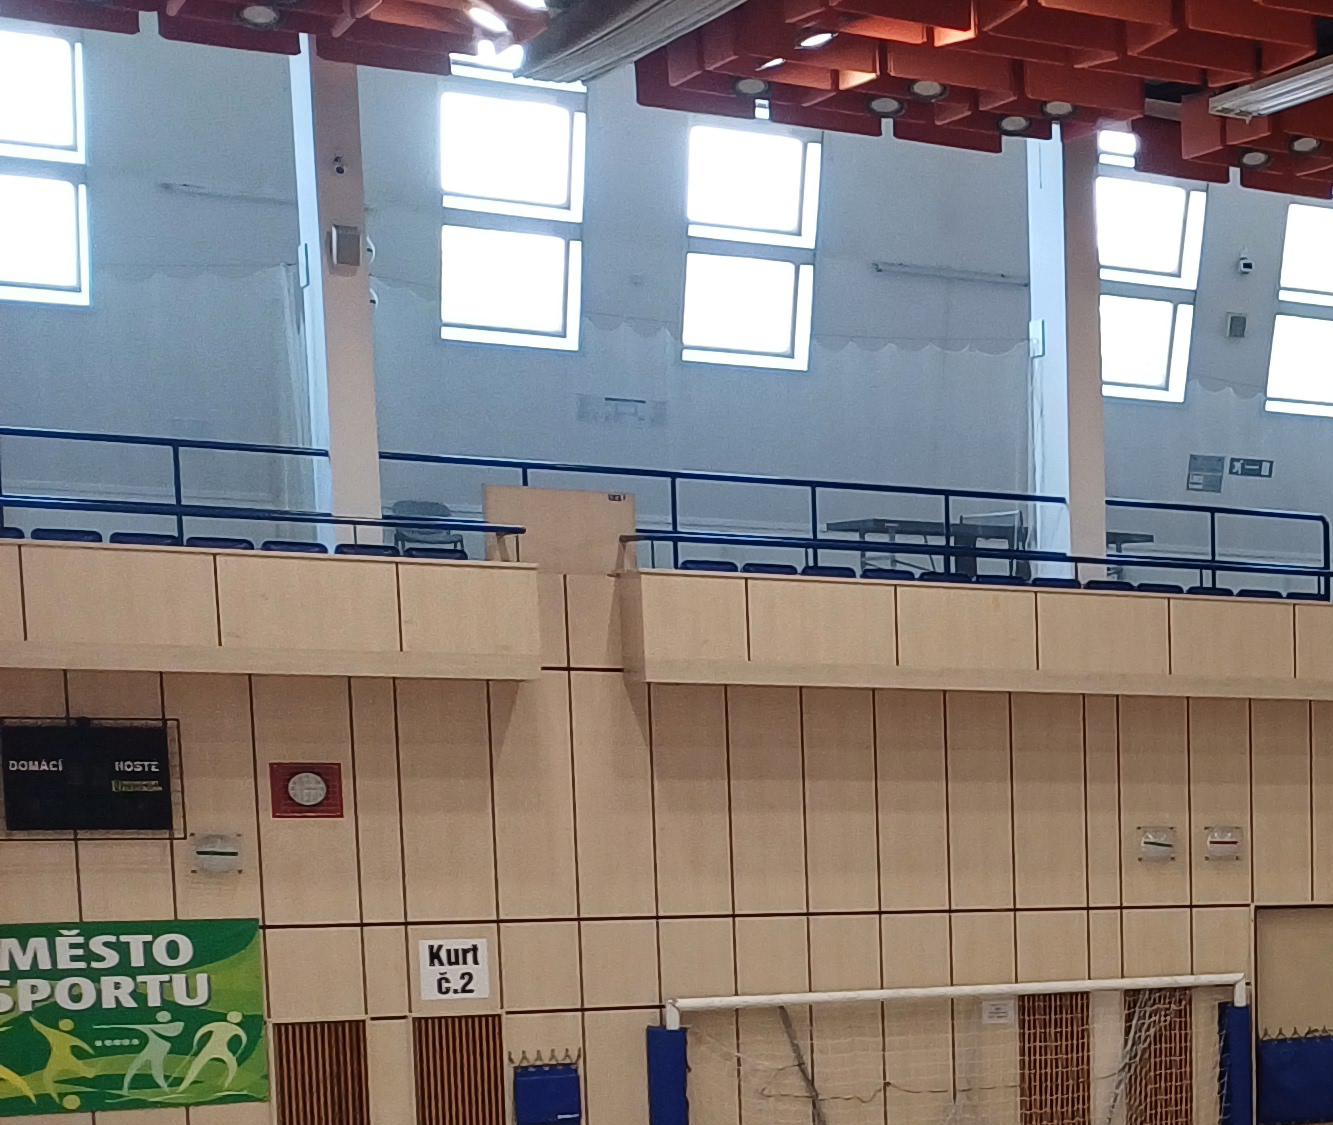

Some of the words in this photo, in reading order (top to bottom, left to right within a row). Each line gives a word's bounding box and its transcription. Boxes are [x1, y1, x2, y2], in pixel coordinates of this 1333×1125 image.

[0, 929, 194, 972] MĚSTO
[427, 943, 480, 967] Kurt
[436, 971, 475, 995] č.2
